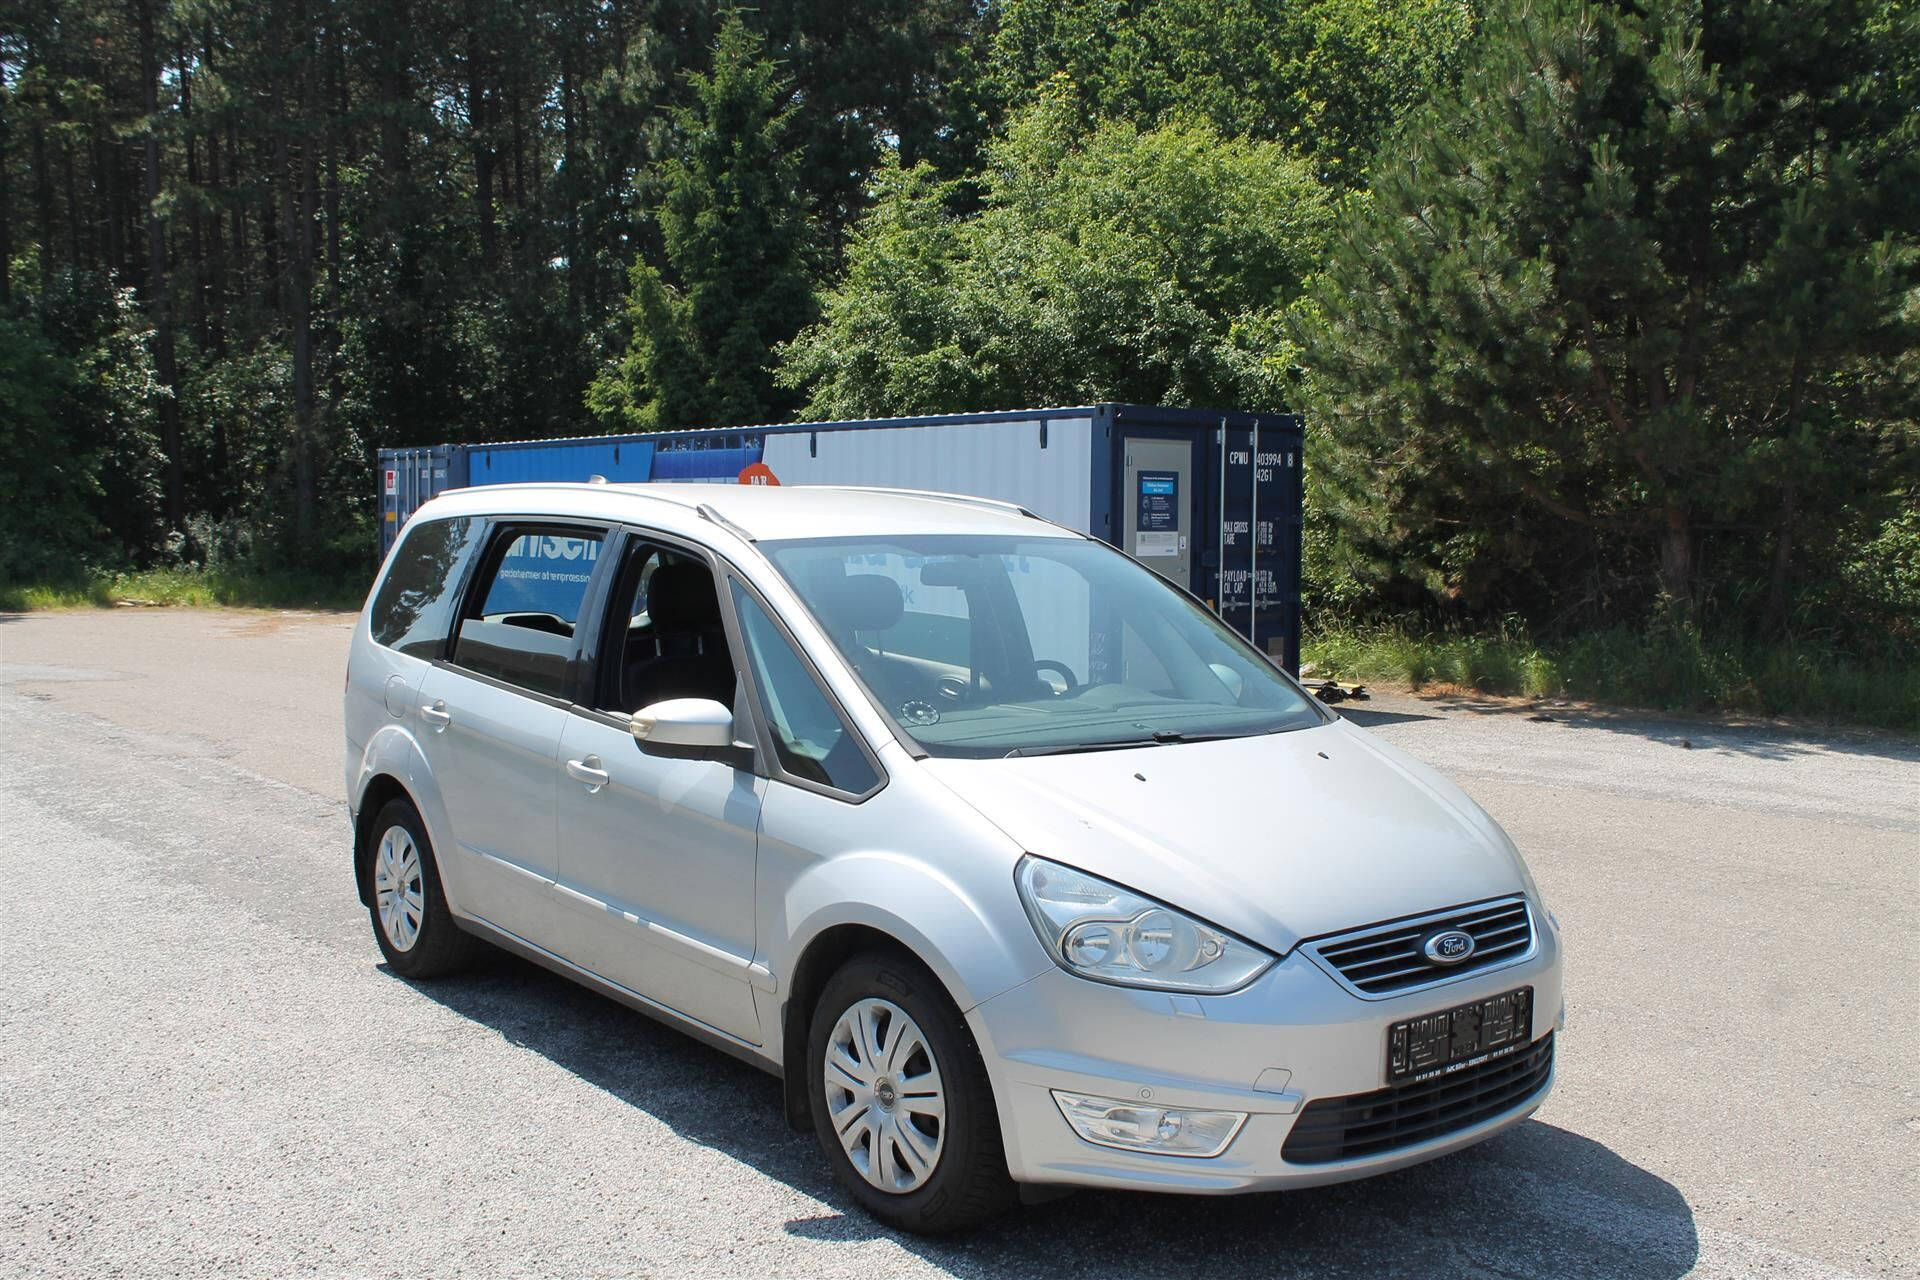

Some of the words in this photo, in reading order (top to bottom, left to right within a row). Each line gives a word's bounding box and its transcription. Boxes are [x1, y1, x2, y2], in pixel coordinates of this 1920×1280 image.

[1229, 451, 1248, 465] CPWU
[1256, 453, 1281, 466] 403994
[1256, 468, 1272, 482] 42G1
[1223, 521, 1233, 533] MAX
[1233, 521, 1248, 533] GROSS
[1223, 533, 1235, 545] TARE
[1224, 570, 1247, 582] PAYLOAD
[1443, 937, 1466, 954] Ford
